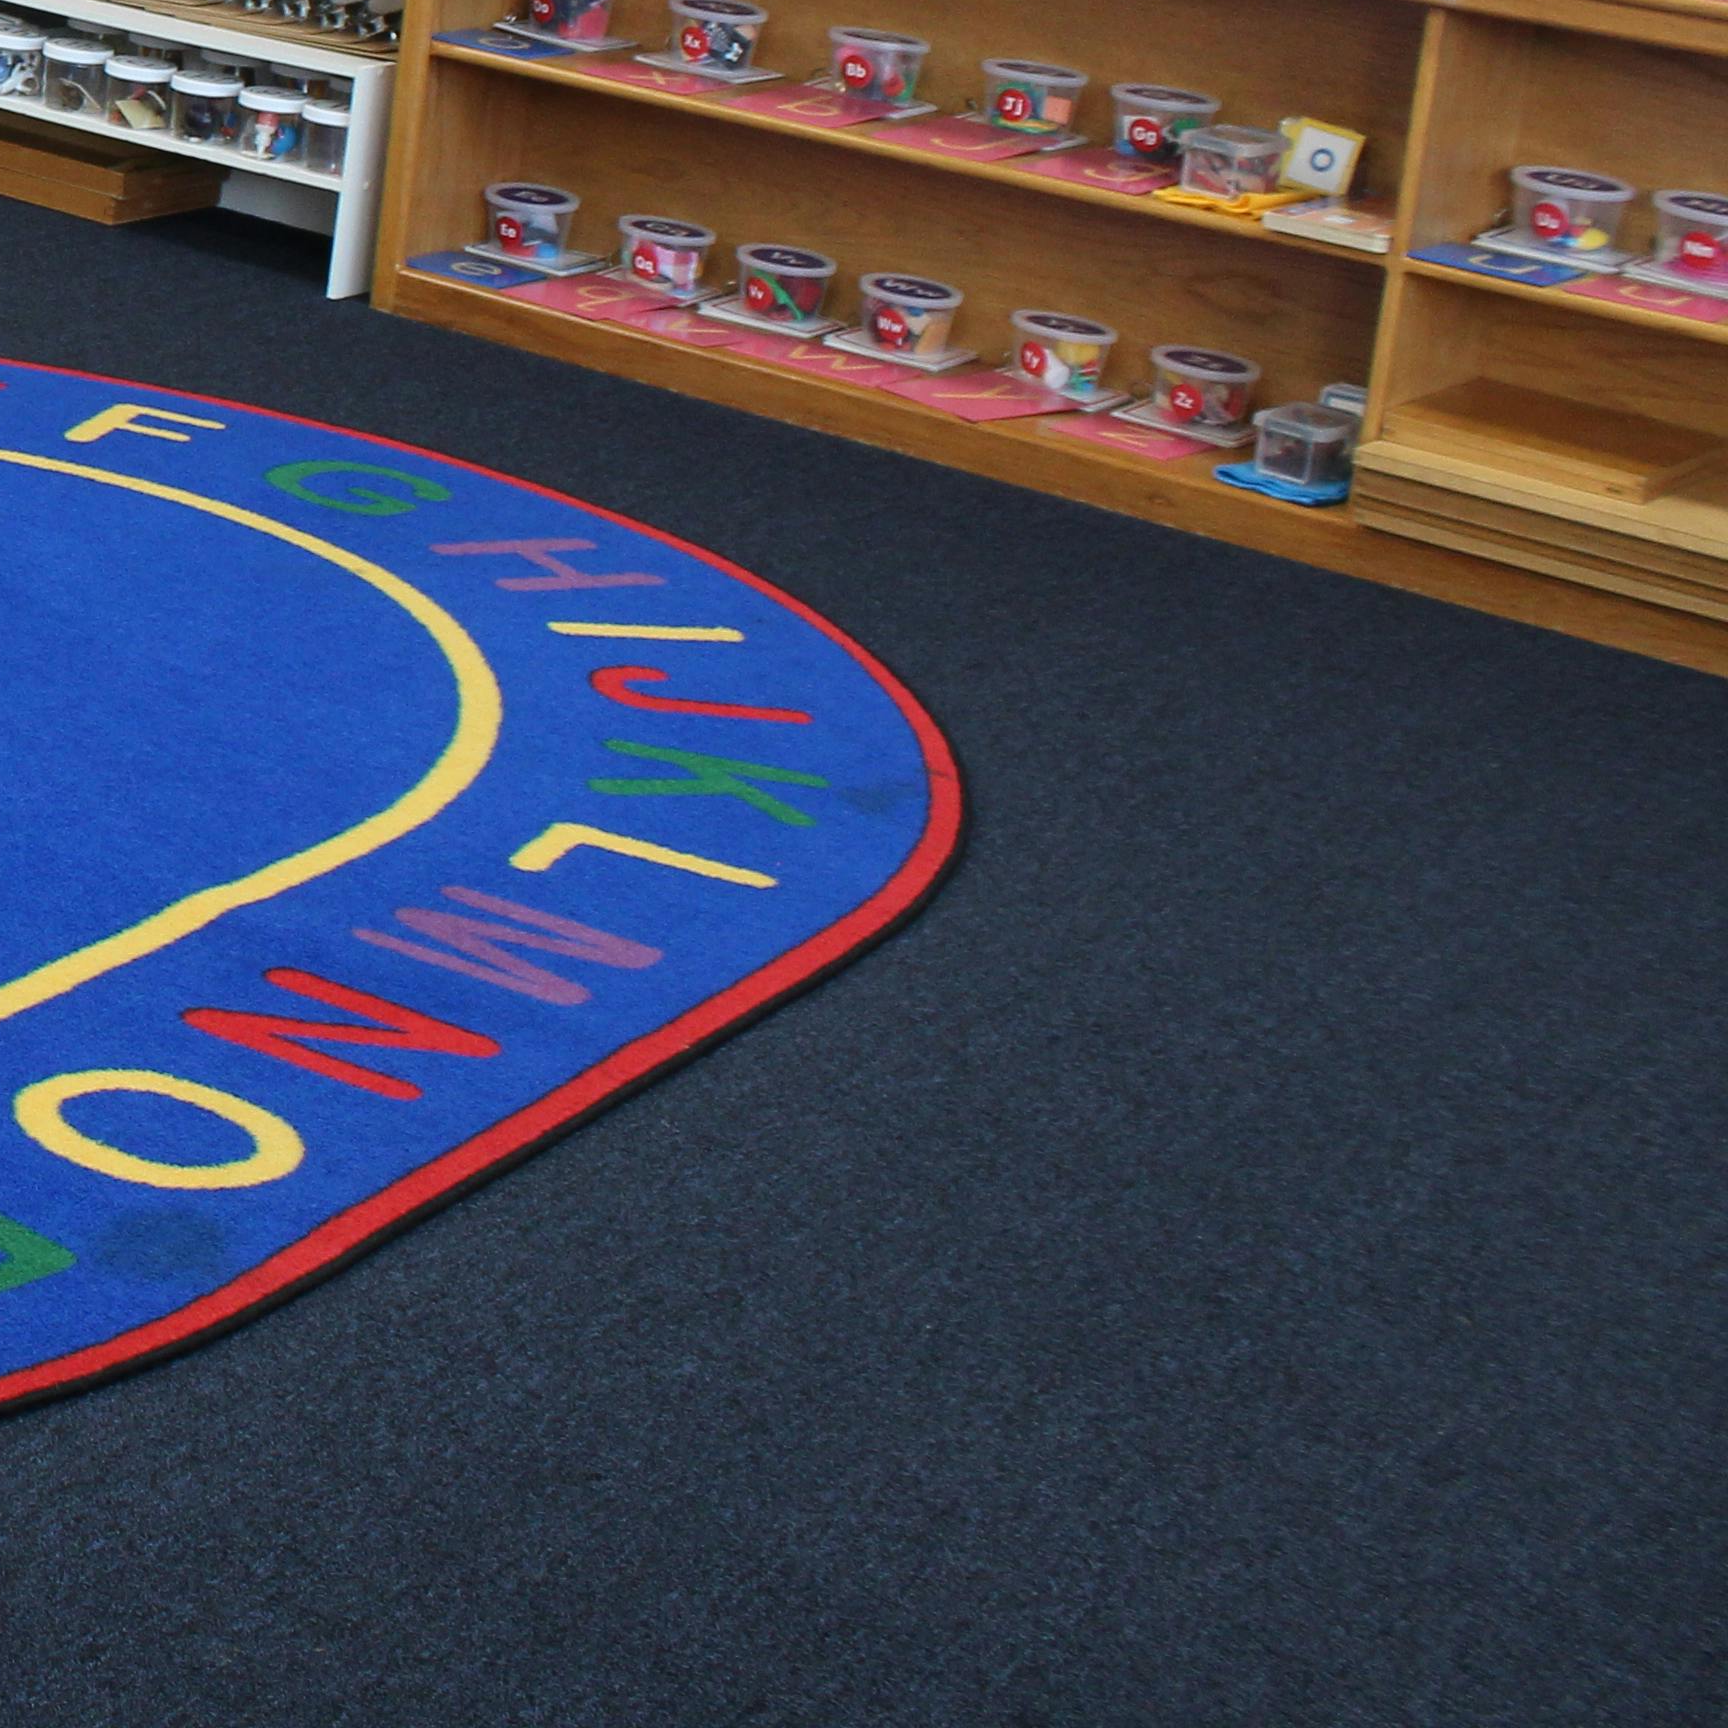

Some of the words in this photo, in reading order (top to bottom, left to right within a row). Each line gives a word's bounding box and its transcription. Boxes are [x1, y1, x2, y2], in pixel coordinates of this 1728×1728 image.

[845, 62, 867, 79] Bb
[1003, 95, 1024, 117] Jj
[1132, 126, 1158, 146] Gg
[500, 225, 517, 239] Ee
[748, 284, 765, 301] Vv
[876, 317, 903, 333] Ww
[1023, 350, 1041, 369] Yy
[1174, 391, 1194, 409] Zz
[62, 403, 228, 443] F
[262, 459, 453, 517] G
[429, 538, 666, 592] H
[544, 621, 746, 643] I
[588, 664, 815, 725] J
[585, 738, 832, 828] K
[507, 821, 779, 889] L
[352, 886, 664, 1006] M
[180, 967, 503, 1102] N
[10, 1067, 308, 1192] O
